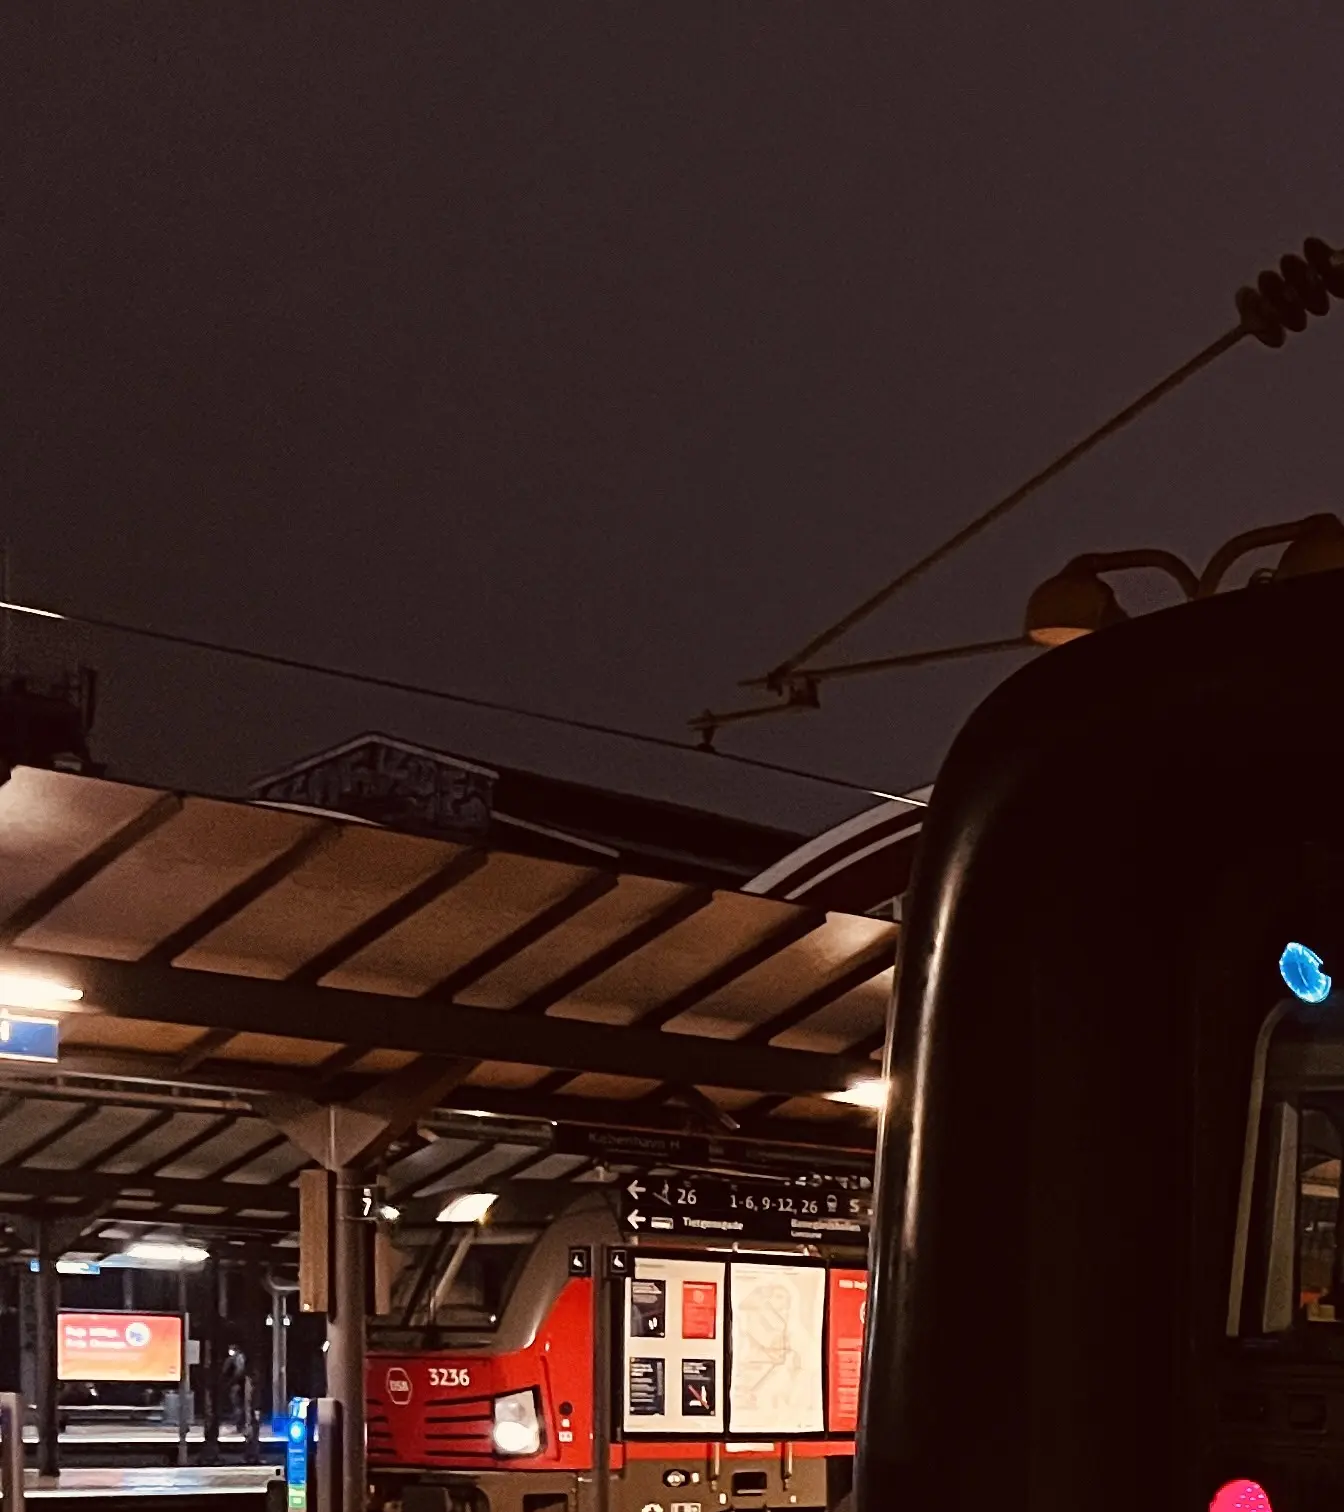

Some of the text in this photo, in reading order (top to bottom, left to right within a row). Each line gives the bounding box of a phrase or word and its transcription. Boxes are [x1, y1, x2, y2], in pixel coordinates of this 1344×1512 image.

[677, 1188, 697, 1205] 26
[801, 1200, 818, 1214] 26
[428, 1368, 470, 1386] 3236
